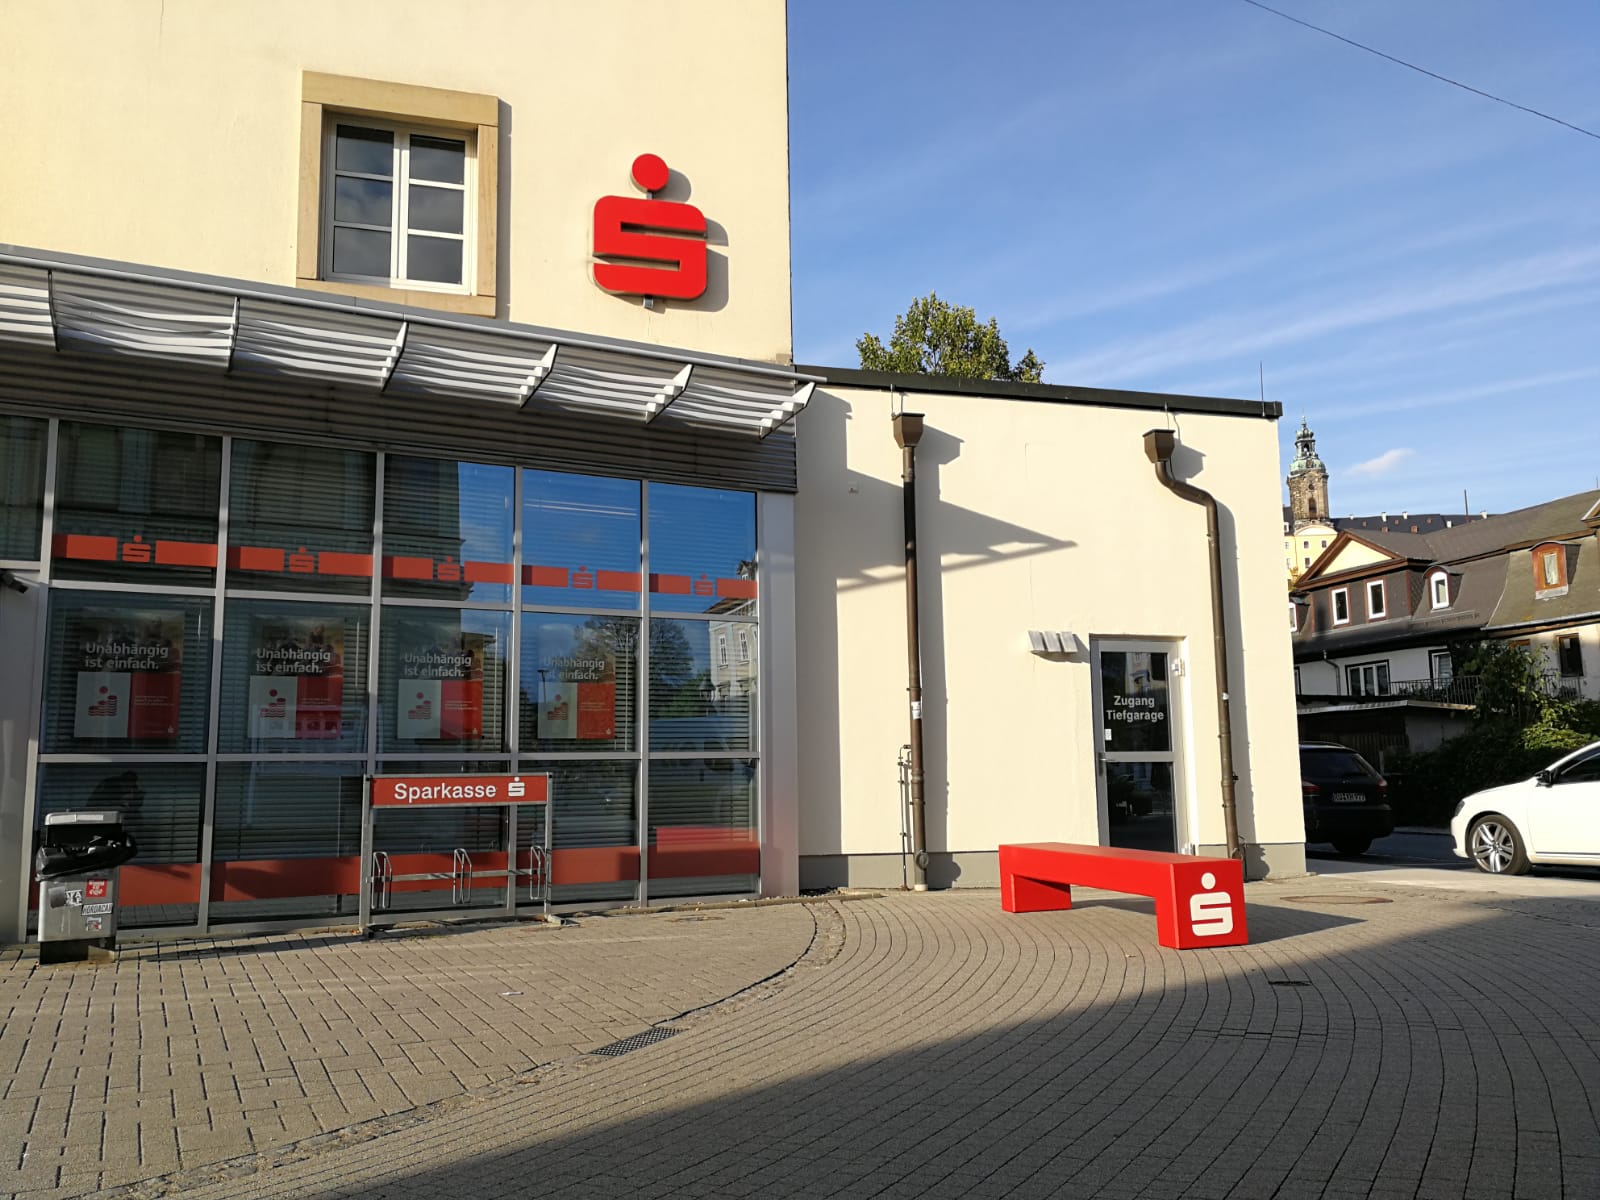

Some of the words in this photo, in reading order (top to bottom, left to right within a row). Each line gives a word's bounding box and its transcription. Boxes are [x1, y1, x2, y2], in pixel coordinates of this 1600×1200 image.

[85, 642, 169, 658] Unabhängig
[256, 647, 331, 662] Unabhängig
[84, 656, 103, 668] ist
[106, 656, 159, 669] einfach.
[404, 652, 472, 667] Unabhängig
[255, 661, 273, 672] ist
[275, 661, 323, 673] einfach.
[404, 664, 418, 676] ist
[1113, 695, 1155, 708] Zugang
[1106, 709, 1165, 723] Tiefgarage
[394, 782, 497, 803] Sparkasse
